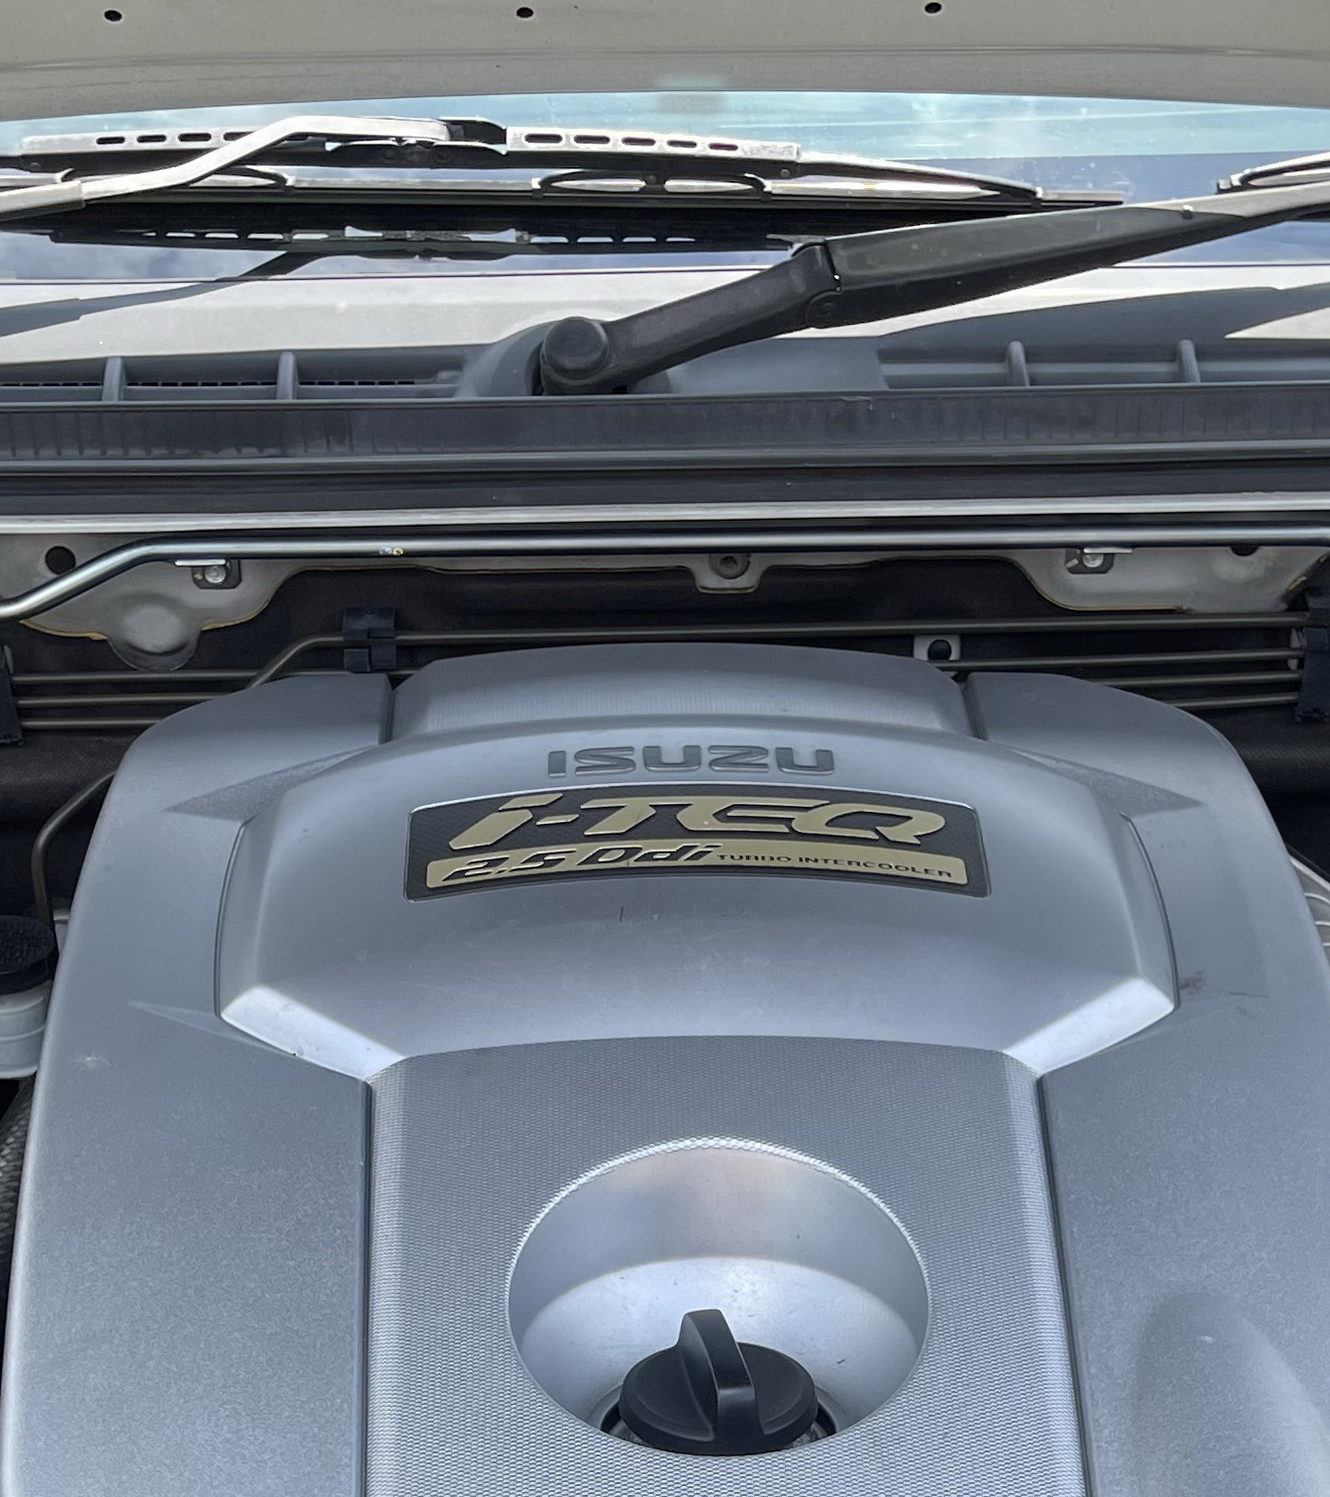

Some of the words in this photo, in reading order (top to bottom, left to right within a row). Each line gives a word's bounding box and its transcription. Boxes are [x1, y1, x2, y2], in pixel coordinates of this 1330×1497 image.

[547, 745, 835, 777] ISUZU
[440, 847, 578, 882] 2.5
[717, 851, 793, 866] TURBO
[797, 856, 953, 880] INTERCOOLER
